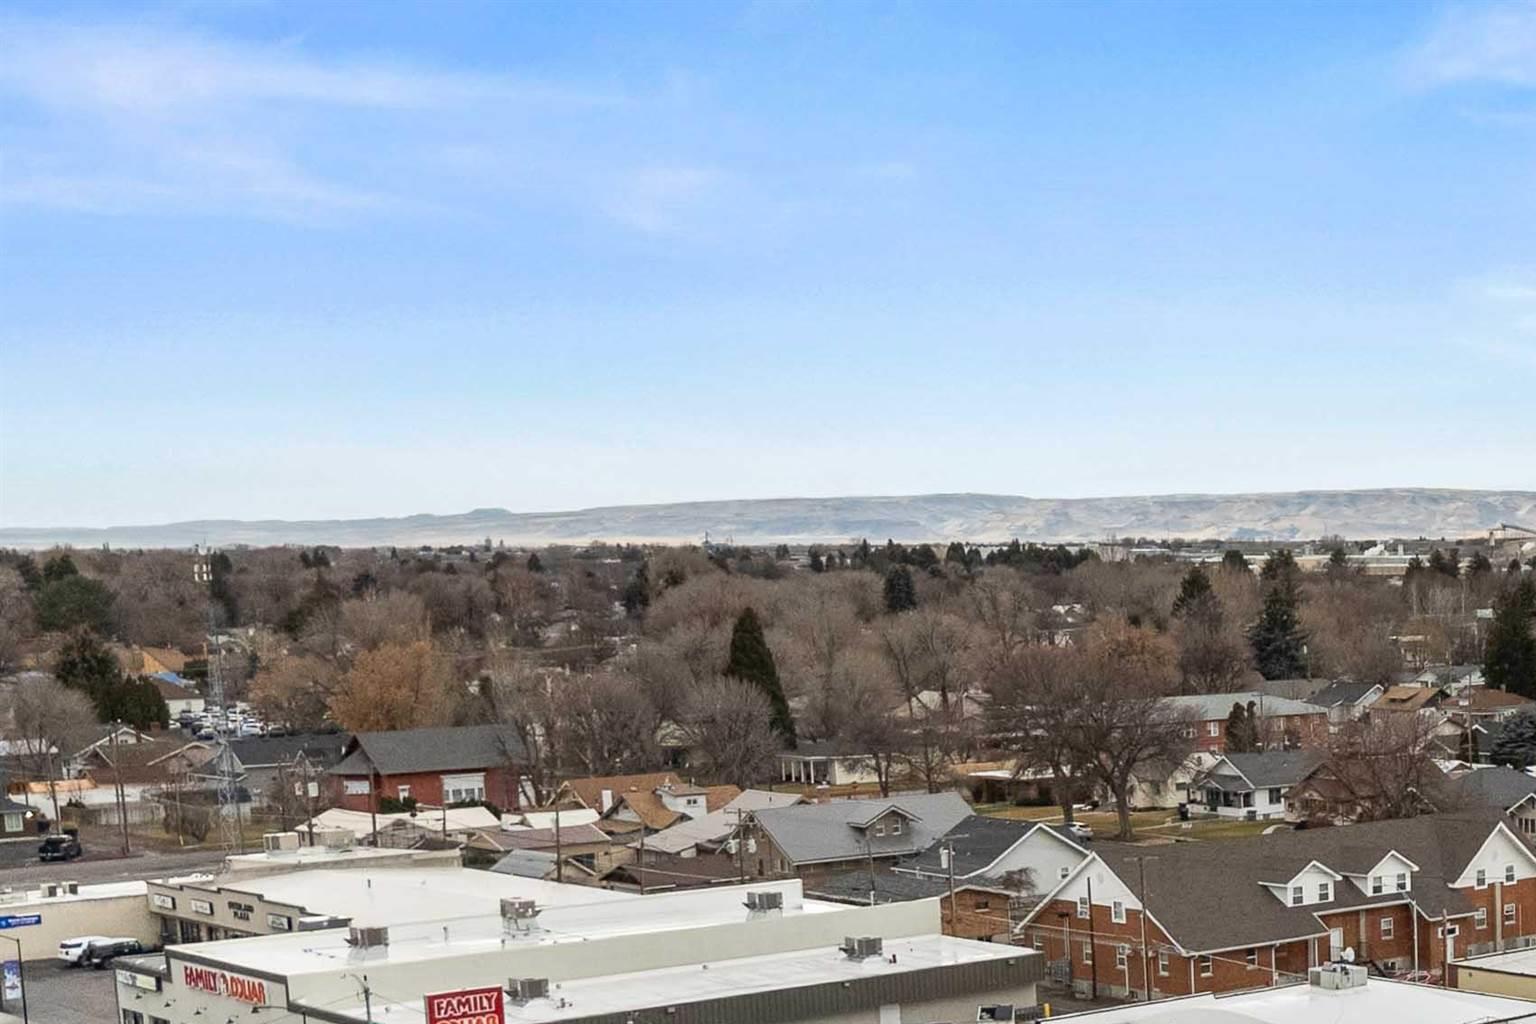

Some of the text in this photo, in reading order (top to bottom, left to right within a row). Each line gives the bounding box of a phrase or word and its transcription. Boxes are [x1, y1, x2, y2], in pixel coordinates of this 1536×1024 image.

[184, 965, 266, 1006] FAMILY DOLLAR
[434, 992, 497, 1019] FAMILY
